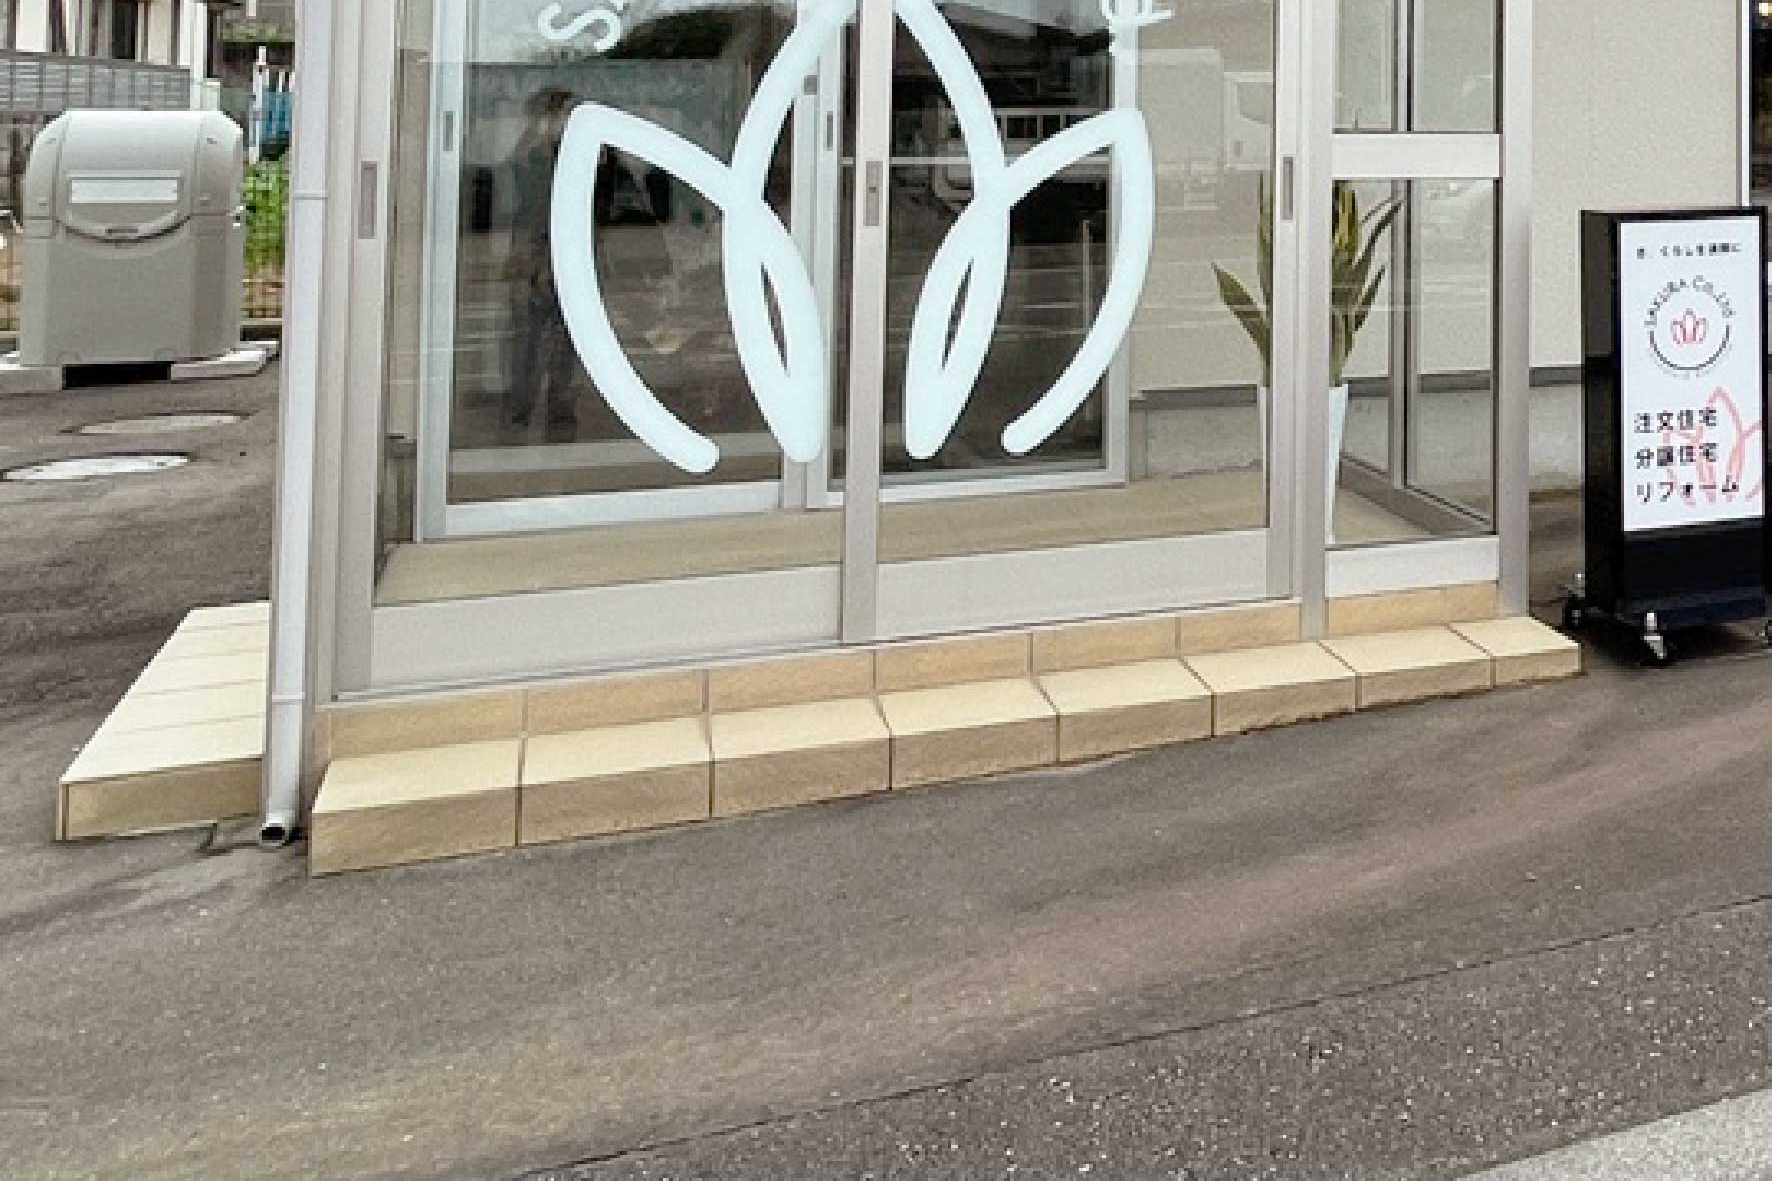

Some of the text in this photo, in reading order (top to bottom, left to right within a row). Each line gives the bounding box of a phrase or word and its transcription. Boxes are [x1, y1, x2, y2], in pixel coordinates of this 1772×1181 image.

[1636, 474, 1741, 503] リフォーム
